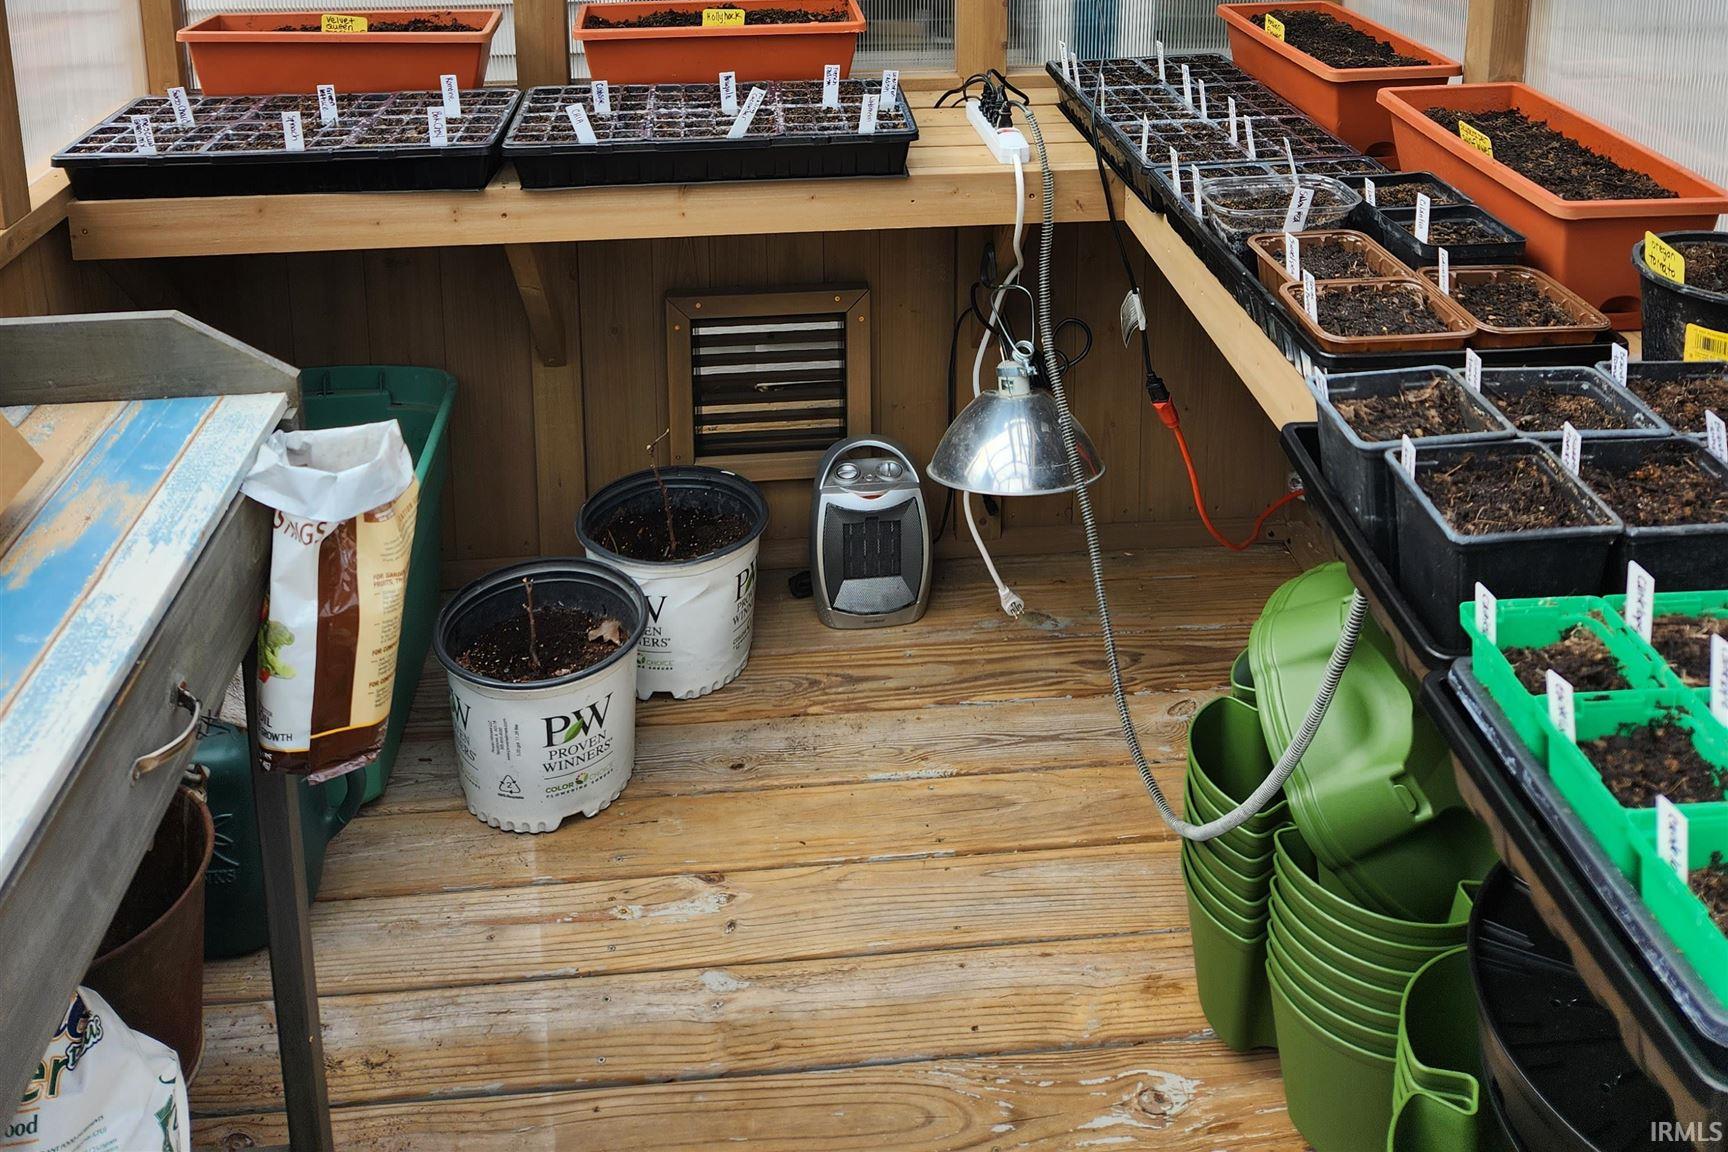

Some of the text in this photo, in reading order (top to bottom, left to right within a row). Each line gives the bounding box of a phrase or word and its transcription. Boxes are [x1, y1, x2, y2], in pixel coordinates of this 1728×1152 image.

[543, 738, 612, 773] WINNERS
[549, 729, 607, 761] PROVEN
[546, 782, 574, 793] COLOR
